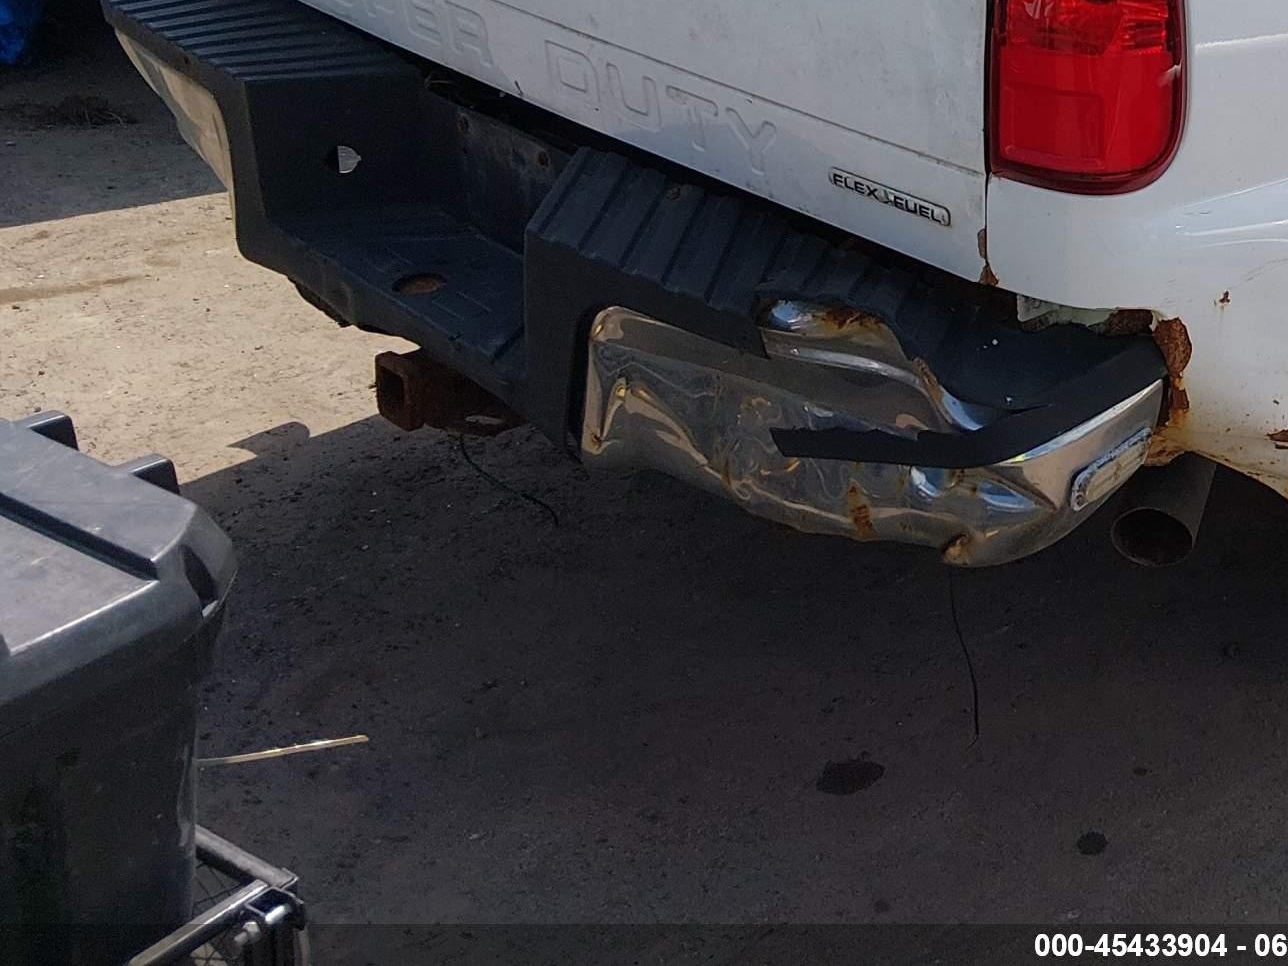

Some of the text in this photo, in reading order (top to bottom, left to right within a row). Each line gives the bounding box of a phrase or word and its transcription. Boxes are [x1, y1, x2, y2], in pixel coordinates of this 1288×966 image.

[543, 39, 778, 176] DUTY
[832, 172, 943, 225] FLEX FUEL
